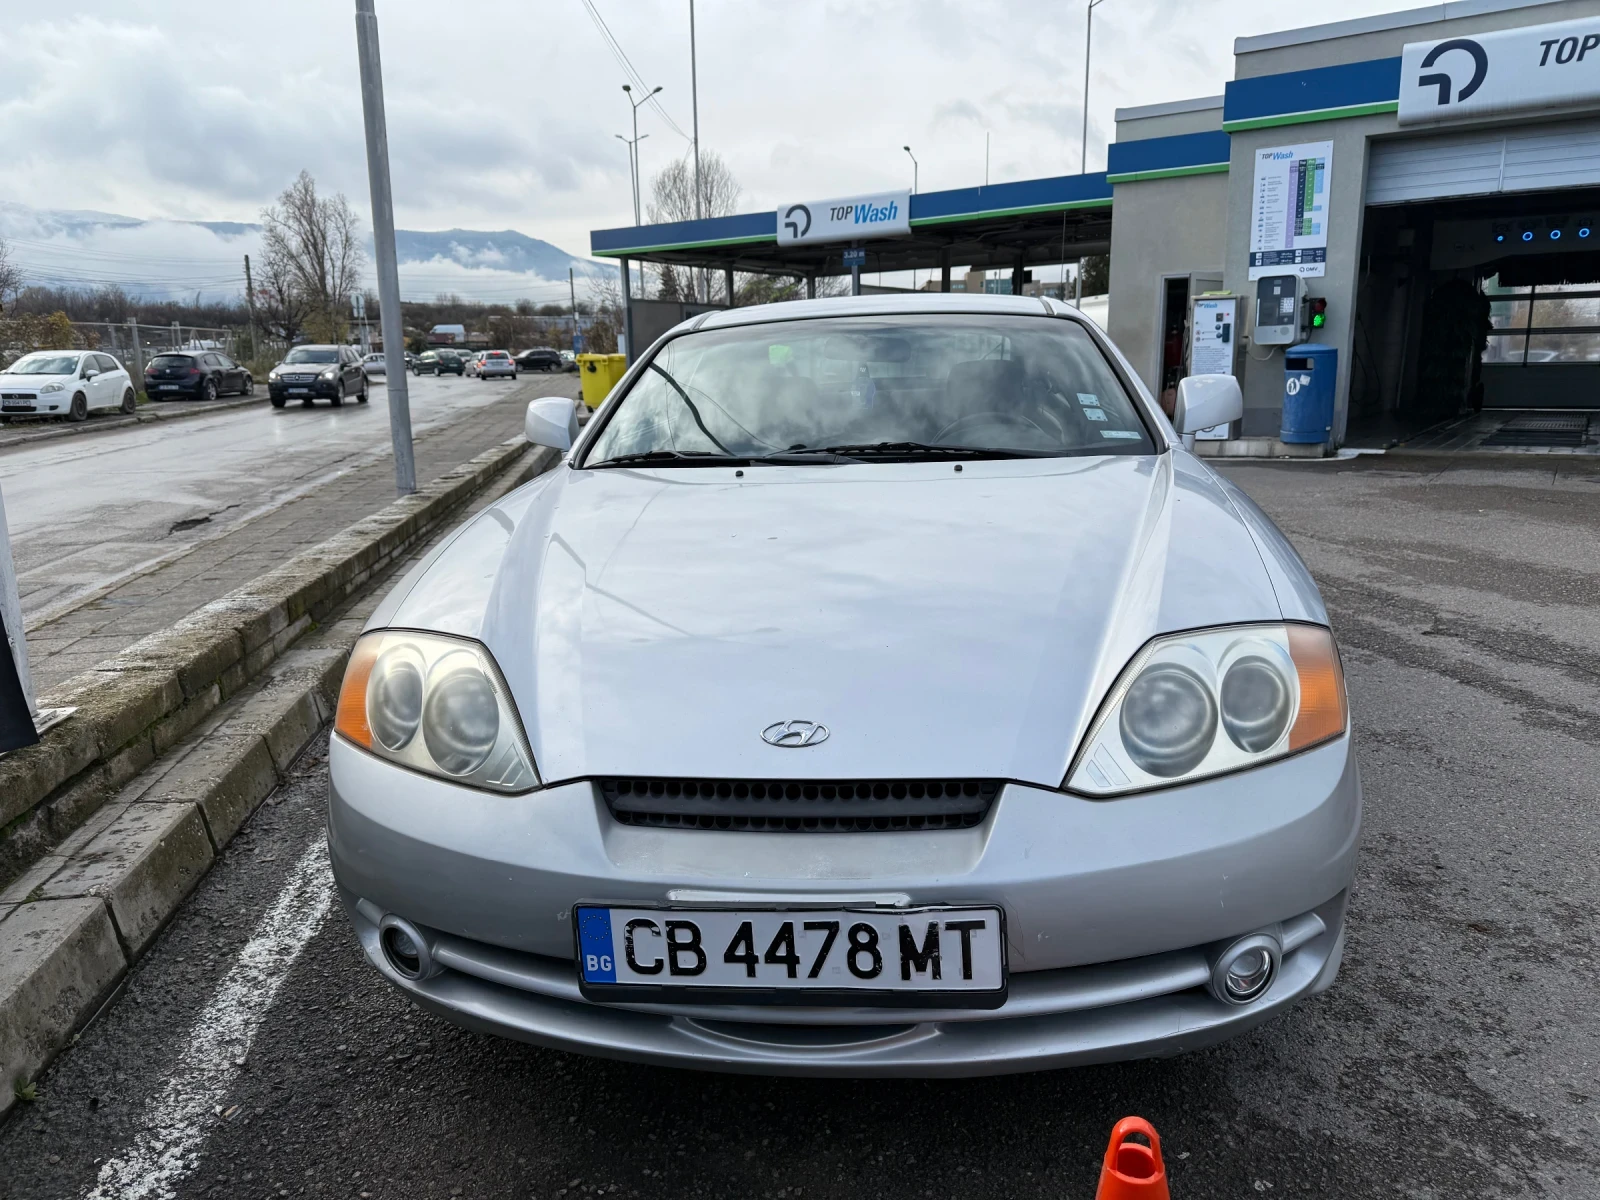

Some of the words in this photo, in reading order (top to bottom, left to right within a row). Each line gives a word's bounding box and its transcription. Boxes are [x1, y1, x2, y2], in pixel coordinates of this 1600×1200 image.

[1539, 33, 1600, 67] TOP
[587, 954, 612, 972] BG
[624, 918, 707, 977] CB
[723, 921, 884, 980] 4478
[899, 920, 986, 982] MT
